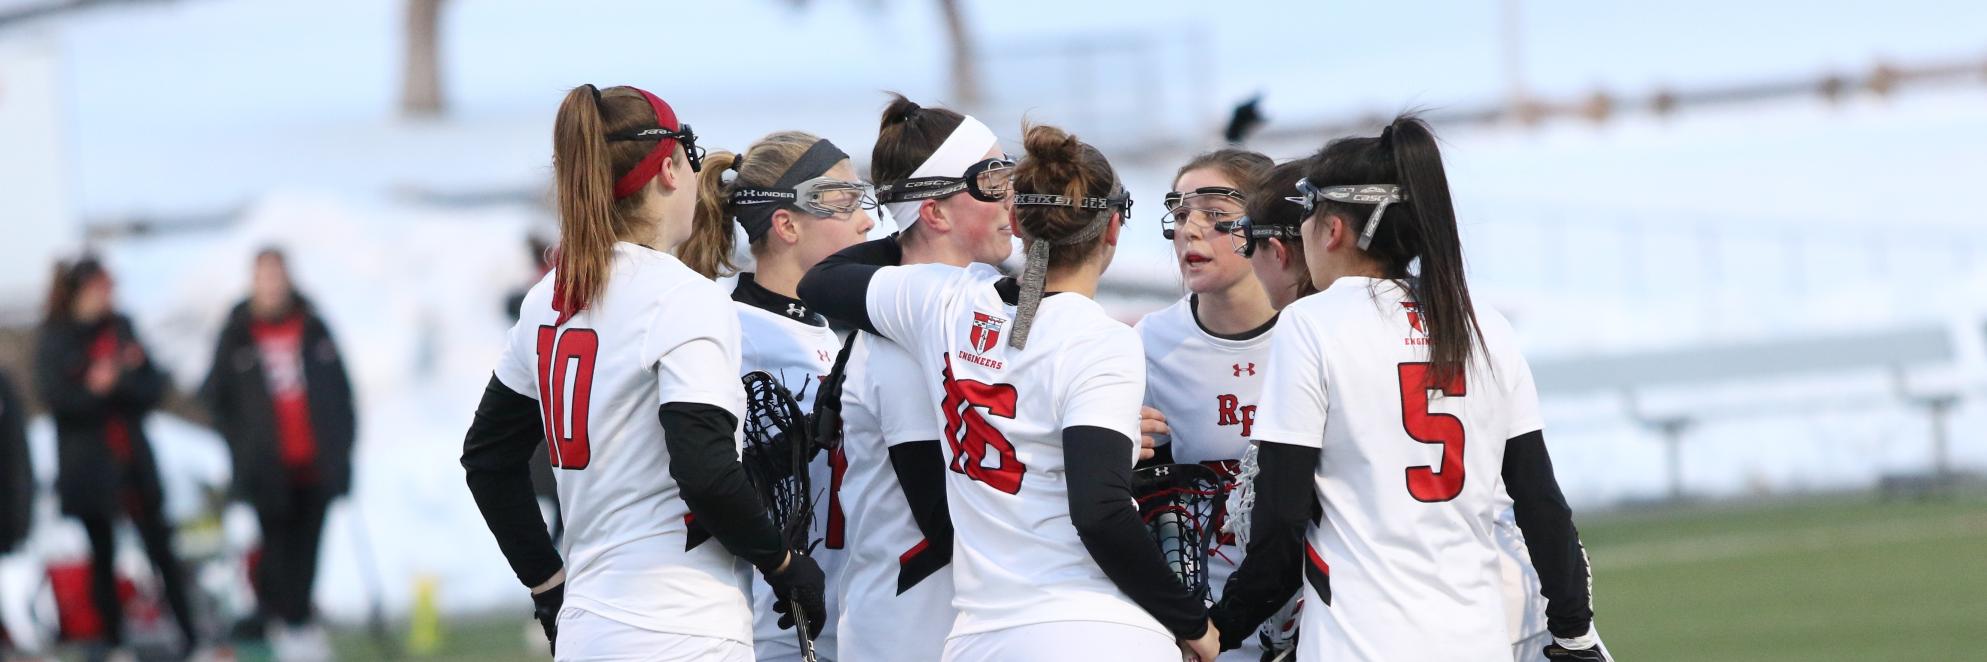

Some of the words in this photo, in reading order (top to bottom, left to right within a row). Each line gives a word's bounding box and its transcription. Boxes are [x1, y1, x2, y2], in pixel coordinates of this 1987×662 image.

[757, 190, 795, 199] UNDER
[903, 181, 968, 200] cascad
[905, 180, 955, 188] casca
[958, 350, 1003, 370] ENGINEERS
[536, 324, 599, 470] 10
[941, 352, 1027, 495] 16
[1216, 394, 1257, 437] RP
[1398, 361, 1467, 503] 5
